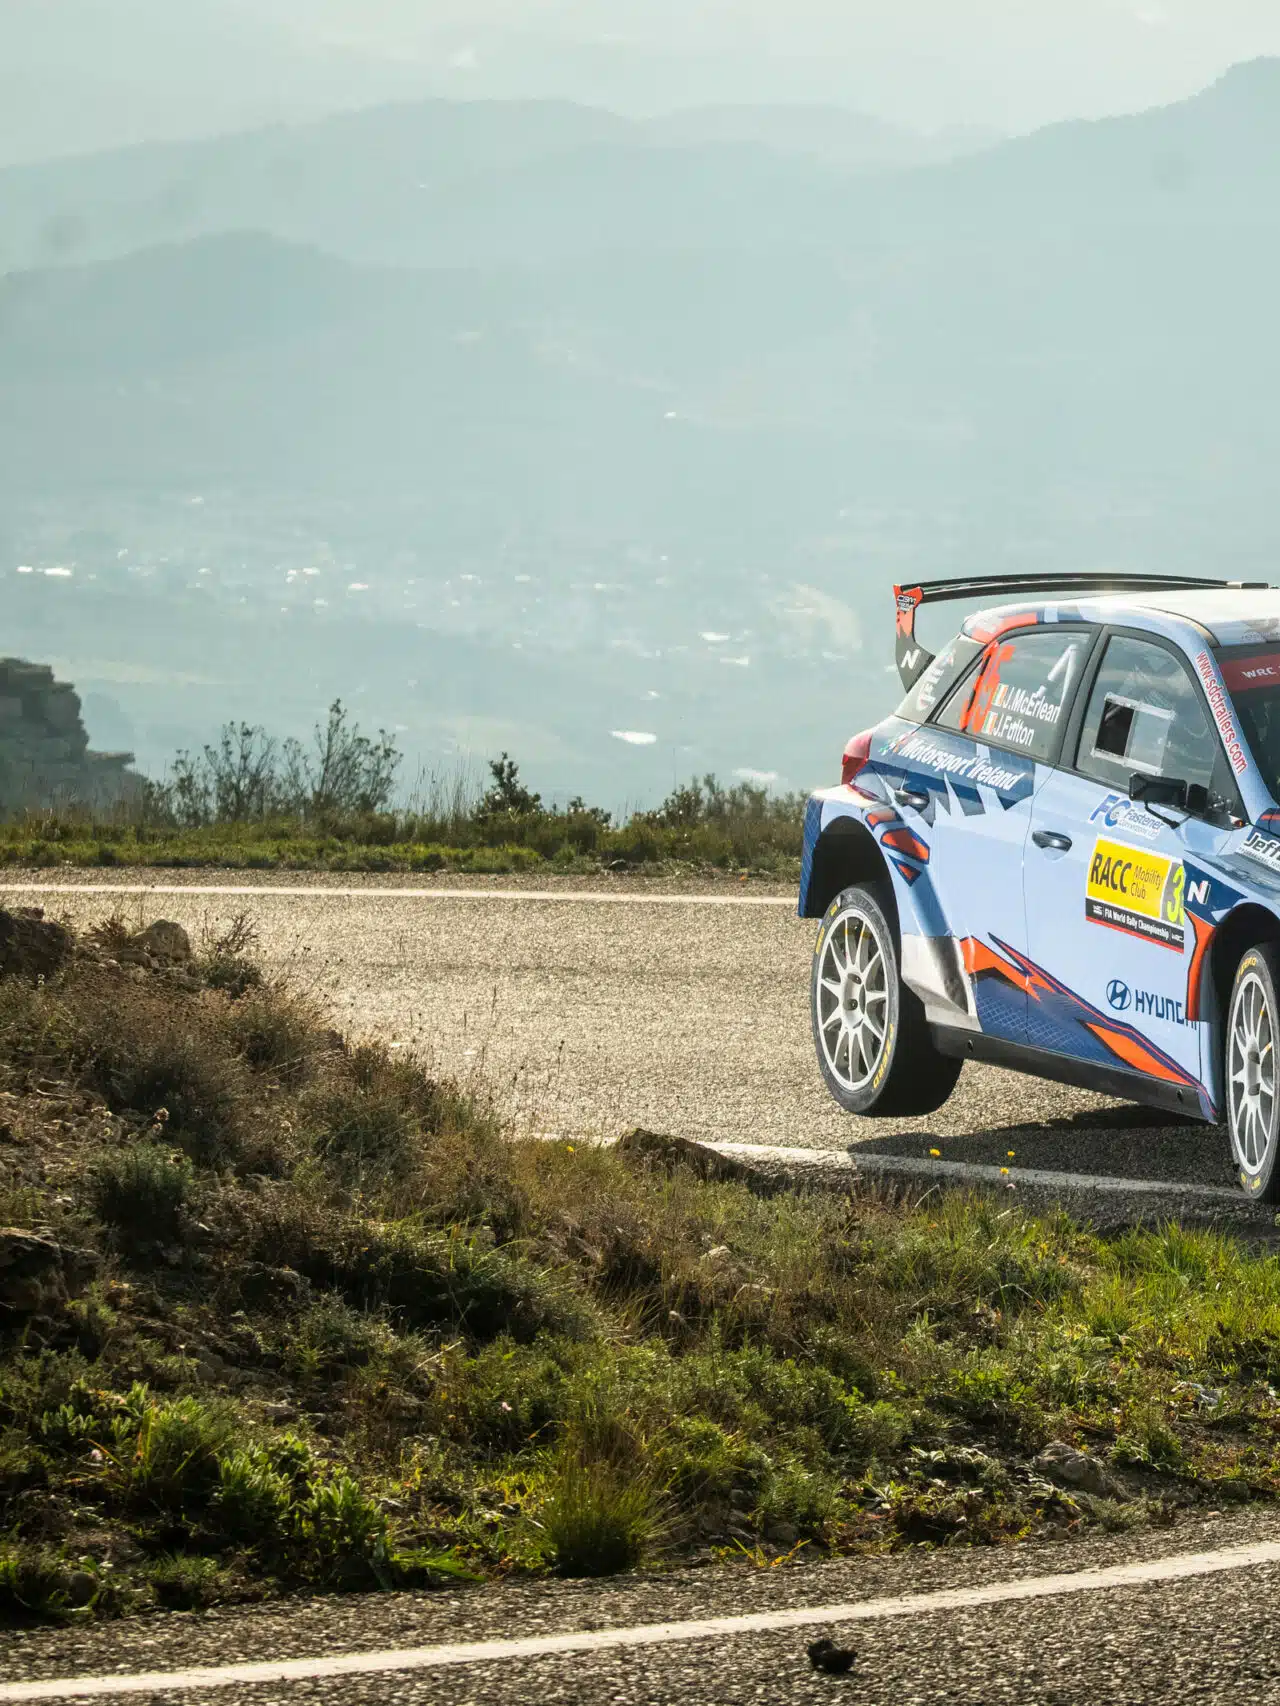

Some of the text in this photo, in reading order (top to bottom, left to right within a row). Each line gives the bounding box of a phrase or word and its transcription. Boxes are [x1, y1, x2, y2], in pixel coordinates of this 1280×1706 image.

[1242, 667, 1277, 680] WRC
[1196, 651, 1248, 775] www.sdctrailers.com
[898, 738, 1027, 791] Motorsport Ireland
[1124, 808, 1165, 830] Fastener
[1090, 852, 1133, 894] RACC
[1134, 865, 1164, 890] Mobility
[1131, 882, 1147, 899] Club
[1105, 908, 1113, 919] FIA
[1113, 911, 1126, 924] World
[1126, 915, 1138, 929] Rally
[1138, 920, 1169, 940] Championship
